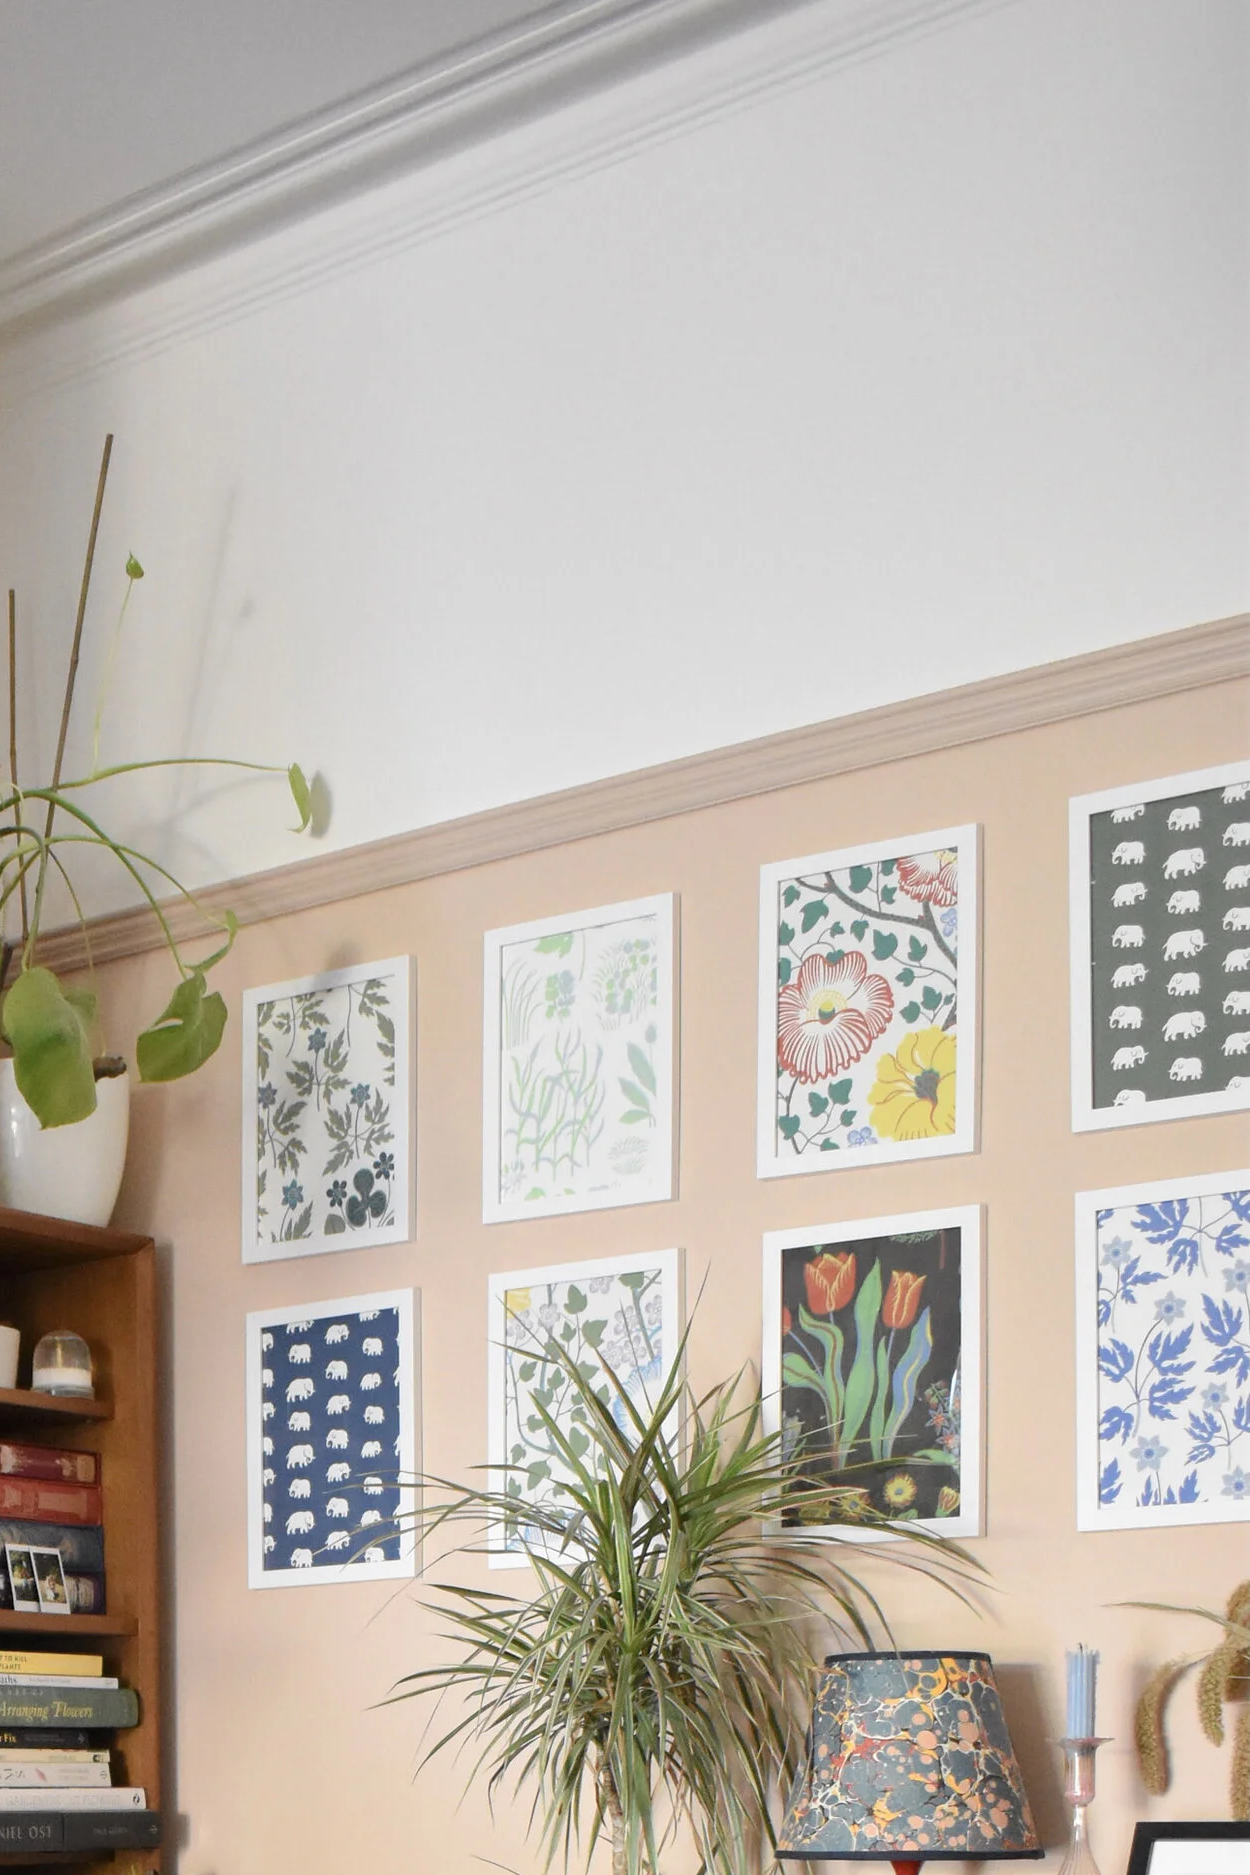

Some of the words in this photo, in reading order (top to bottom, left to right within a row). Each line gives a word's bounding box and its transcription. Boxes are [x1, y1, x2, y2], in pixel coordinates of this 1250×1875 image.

[50, 1700, 94, 1718] Flowers
[4, 1733, 17, 1743] Fix
[28, 1825, 52, 1840] OST
